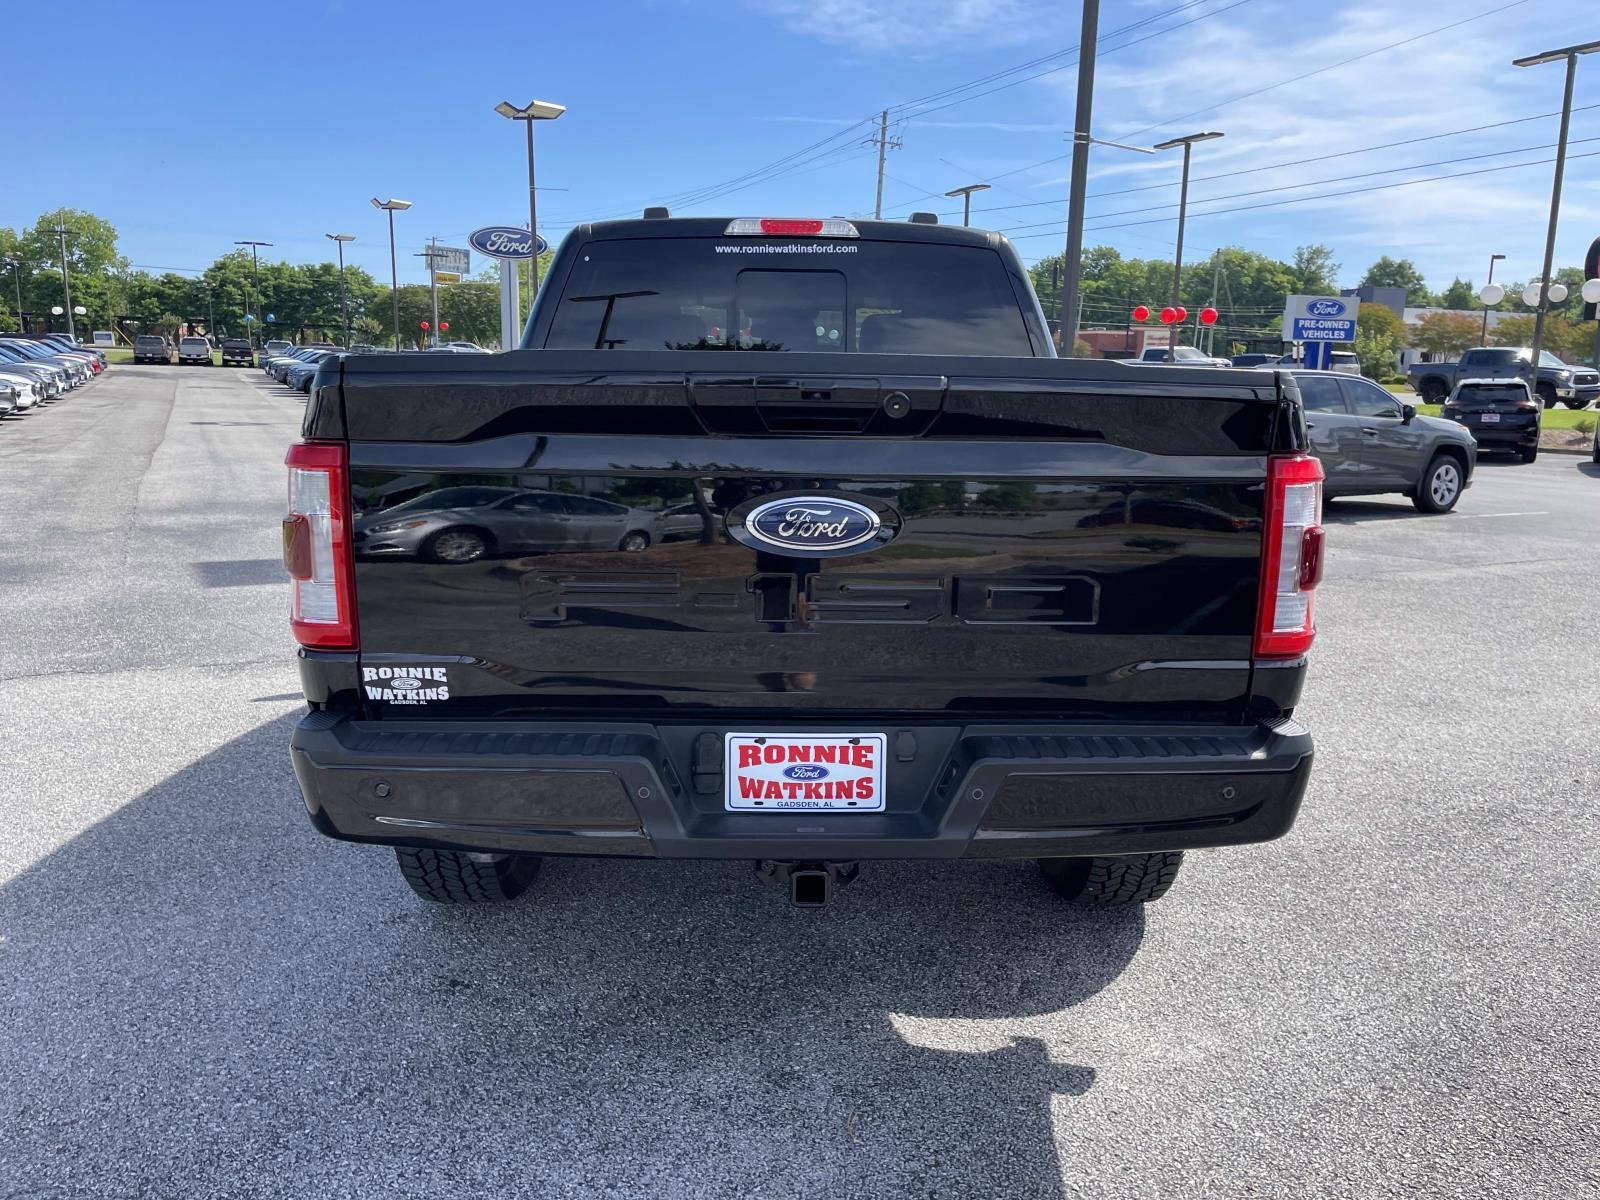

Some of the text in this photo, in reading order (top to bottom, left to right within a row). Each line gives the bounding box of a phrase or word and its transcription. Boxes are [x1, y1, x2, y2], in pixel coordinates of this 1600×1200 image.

[486, 232, 532, 253] Ford
[715, 244, 858, 254] www.ronniewatkinsford.com
[1313, 301, 1339, 314] Ford
[1298, 319, 1351, 329] PRE-OWNED
[1302, 330, 1345, 339] VEHICLES
[778, 508, 849, 537] Ford
[362, 667, 448, 682] RONNIE
[364, 685, 450, 700] WATKINS
[738, 745, 874, 769] RONNIE
[791, 766, 820, 778] Ford
[738, 776, 874, 800] WATKINS
